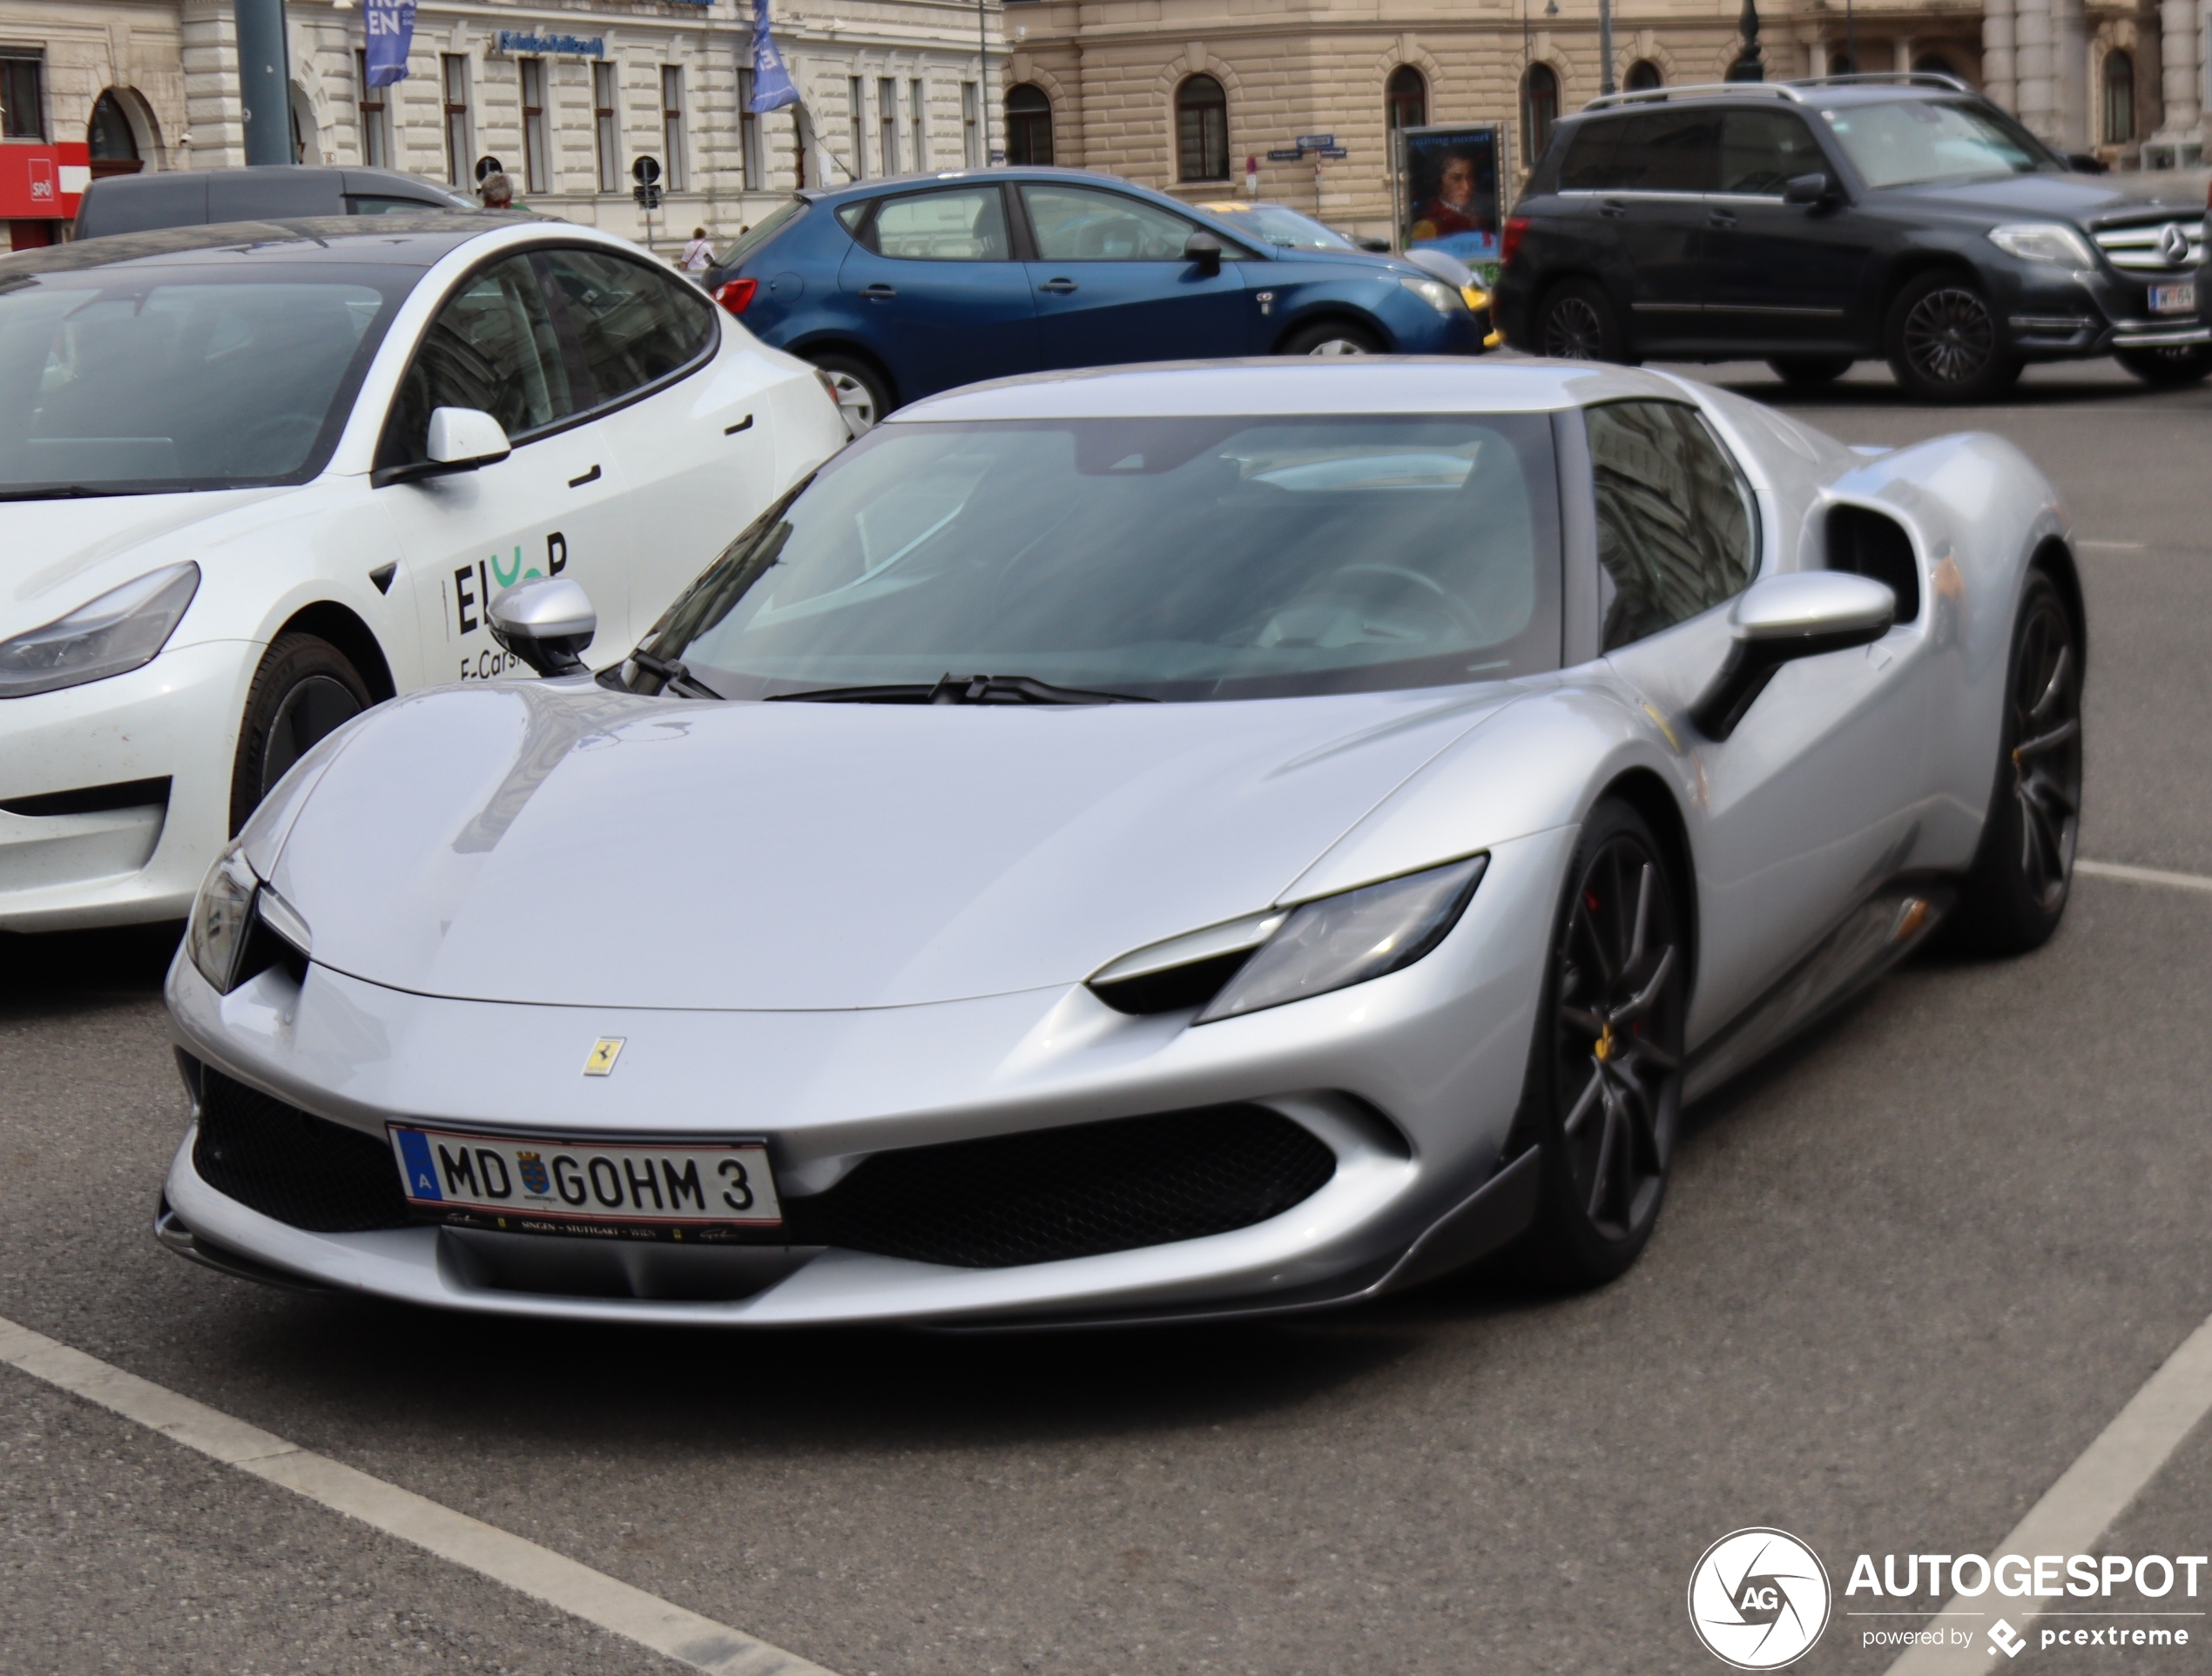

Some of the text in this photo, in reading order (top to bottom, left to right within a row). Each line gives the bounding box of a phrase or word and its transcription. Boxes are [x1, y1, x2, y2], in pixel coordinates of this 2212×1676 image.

[368, 10, 401, 35] EN
[32, 179, 51, 197] SPÖ
[419, 1173, 432, 1188] A
[438, 1143, 753, 1210] MD GOHM 3
[522, 1221, 556, 1230] SINGEN
[567, 1224, 618, 1235] STUTTGART
